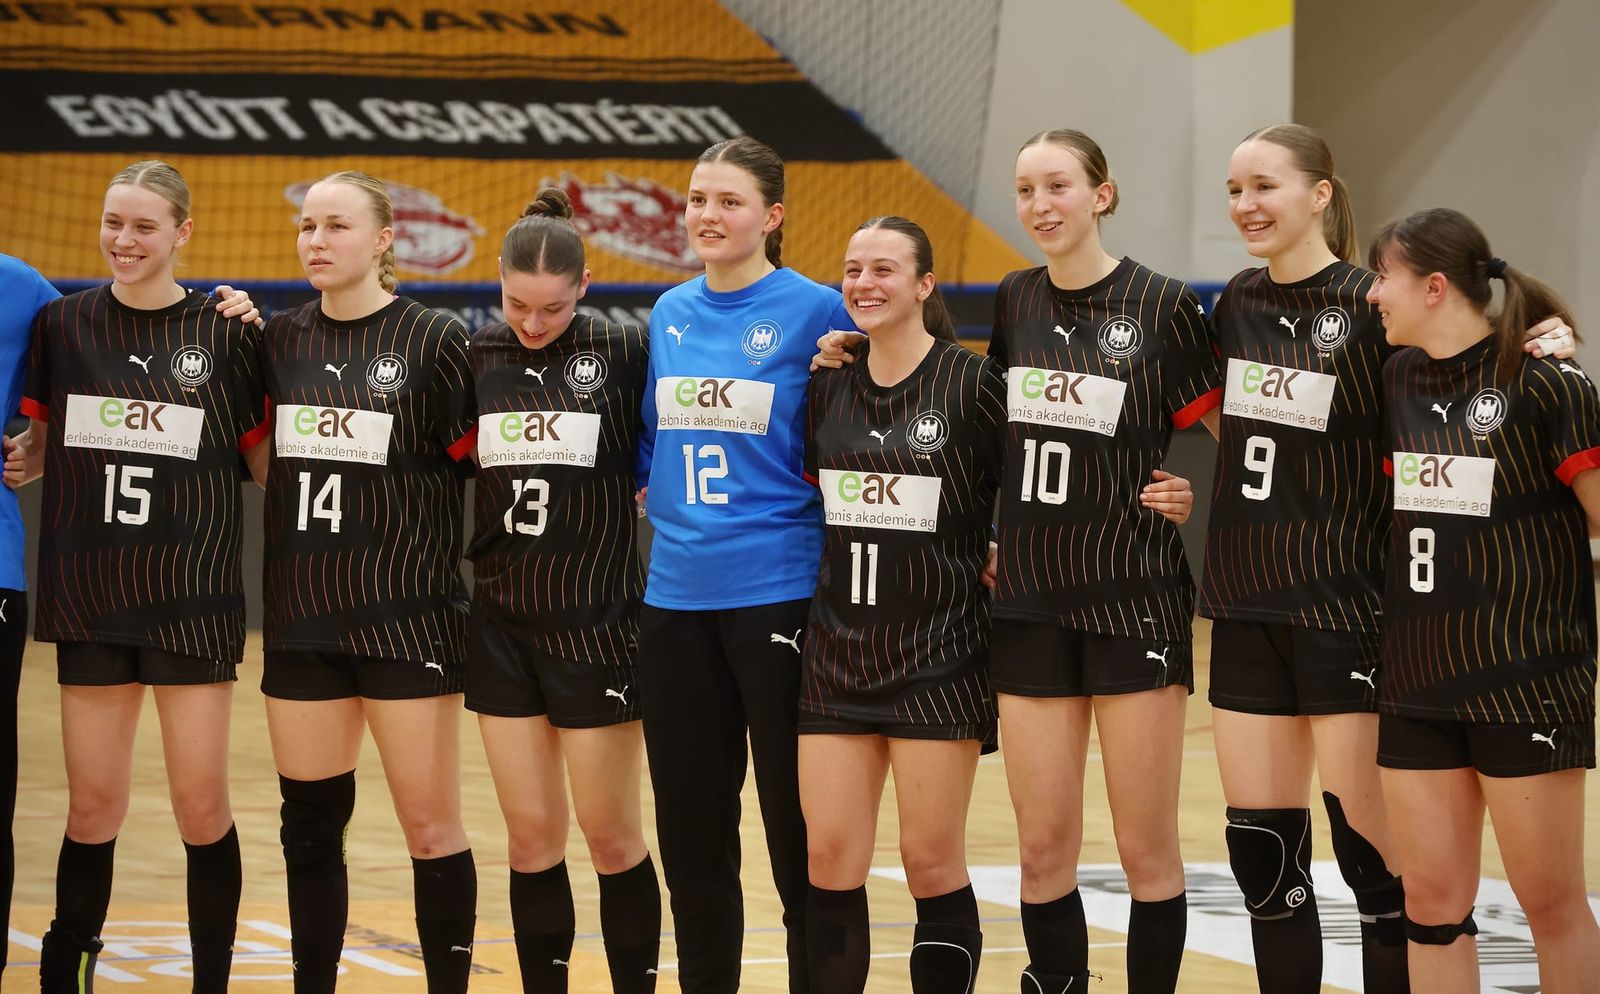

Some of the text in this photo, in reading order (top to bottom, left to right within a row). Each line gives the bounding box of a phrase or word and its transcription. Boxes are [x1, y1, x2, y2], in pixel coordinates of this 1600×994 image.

[0, 4, 628, 37] ETTERMANN
[47, 89, 306, 140] EGYÜTT
[309, 98, 377, 140] A
[675, 378, 736, 409] eak
[1021, 368, 1087, 405] eak
[1242, 363, 1301, 401] eak
[99, 399, 167, 432] eak
[294, 406, 355, 439] eak
[499, 412, 562, 443] eak
[659, 413, 767, 434] ebnis akademie ag
[1036, 408, 1096, 428] akademie
[1099, 420, 1115, 435] ag
[1252, 402, 1306, 424] akademie
[1309, 416, 1326, 431] ag
[66, 431, 197, 459] erlebnis akademie ag
[310, 443, 368, 460] akademie
[371, 451, 386, 463] ag
[519, 448, 577, 461] akademie
[579, 453, 595, 466] ag
[683, 445, 728, 504] 12
[1021, 439, 1070, 504] 10
[1242, 436, 1275, 500] 9
[1401, 454, 1456, 488] eak
[105, 465, 153, 525] 15
[298, 472, 341, 532] 14
[838, 472, 902, 506] eak
[1412, 493, 1467, 511] akademie
[1471, 501, 1489, 515] ag
[504, 479, 549, 536] 13
[855, 510, 916, 527] akademie
[920, 518, 935, 532] ag
[851, 542, 878, 605] 11
[1410, 528, 1435, 592] 8
